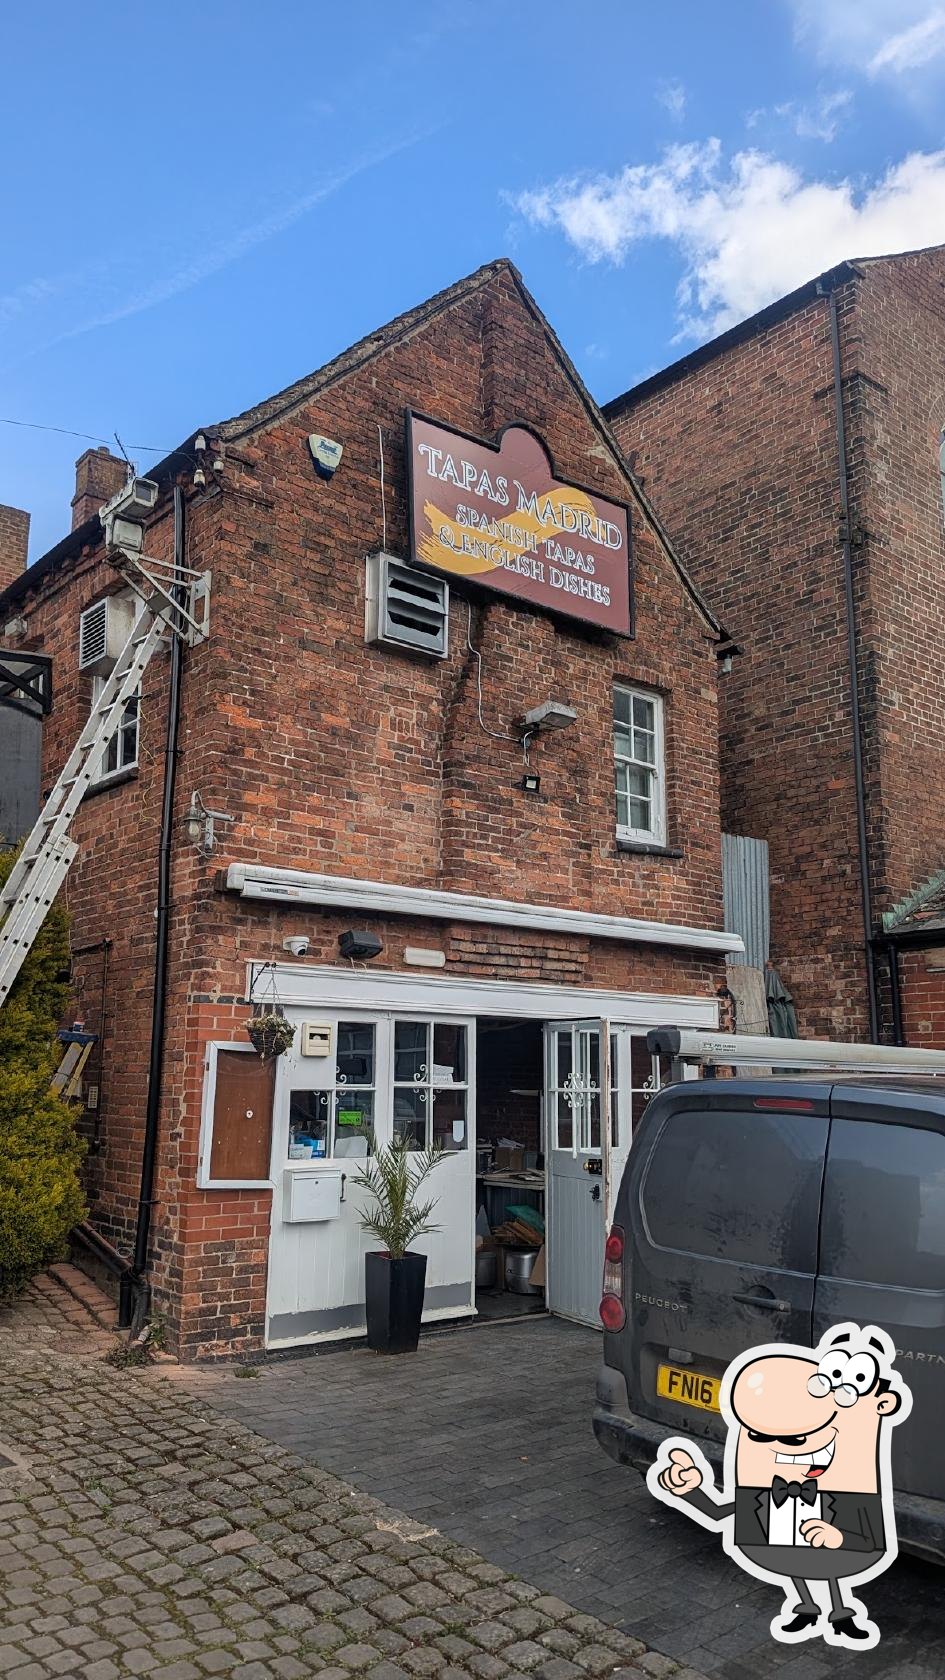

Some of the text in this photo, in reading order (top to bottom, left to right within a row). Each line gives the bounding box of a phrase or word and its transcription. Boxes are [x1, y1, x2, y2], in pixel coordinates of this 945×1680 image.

[418, 443, 623, 550] TAPAS MADRID
[439, 524, 611, 606] & ENGLISH DISHES
[456, 503, 595, 575] SPANISH TAPAS
[635, 1292, 688, 1311] PEUGEOT
[668, 1370, 713, 1404] FN16
